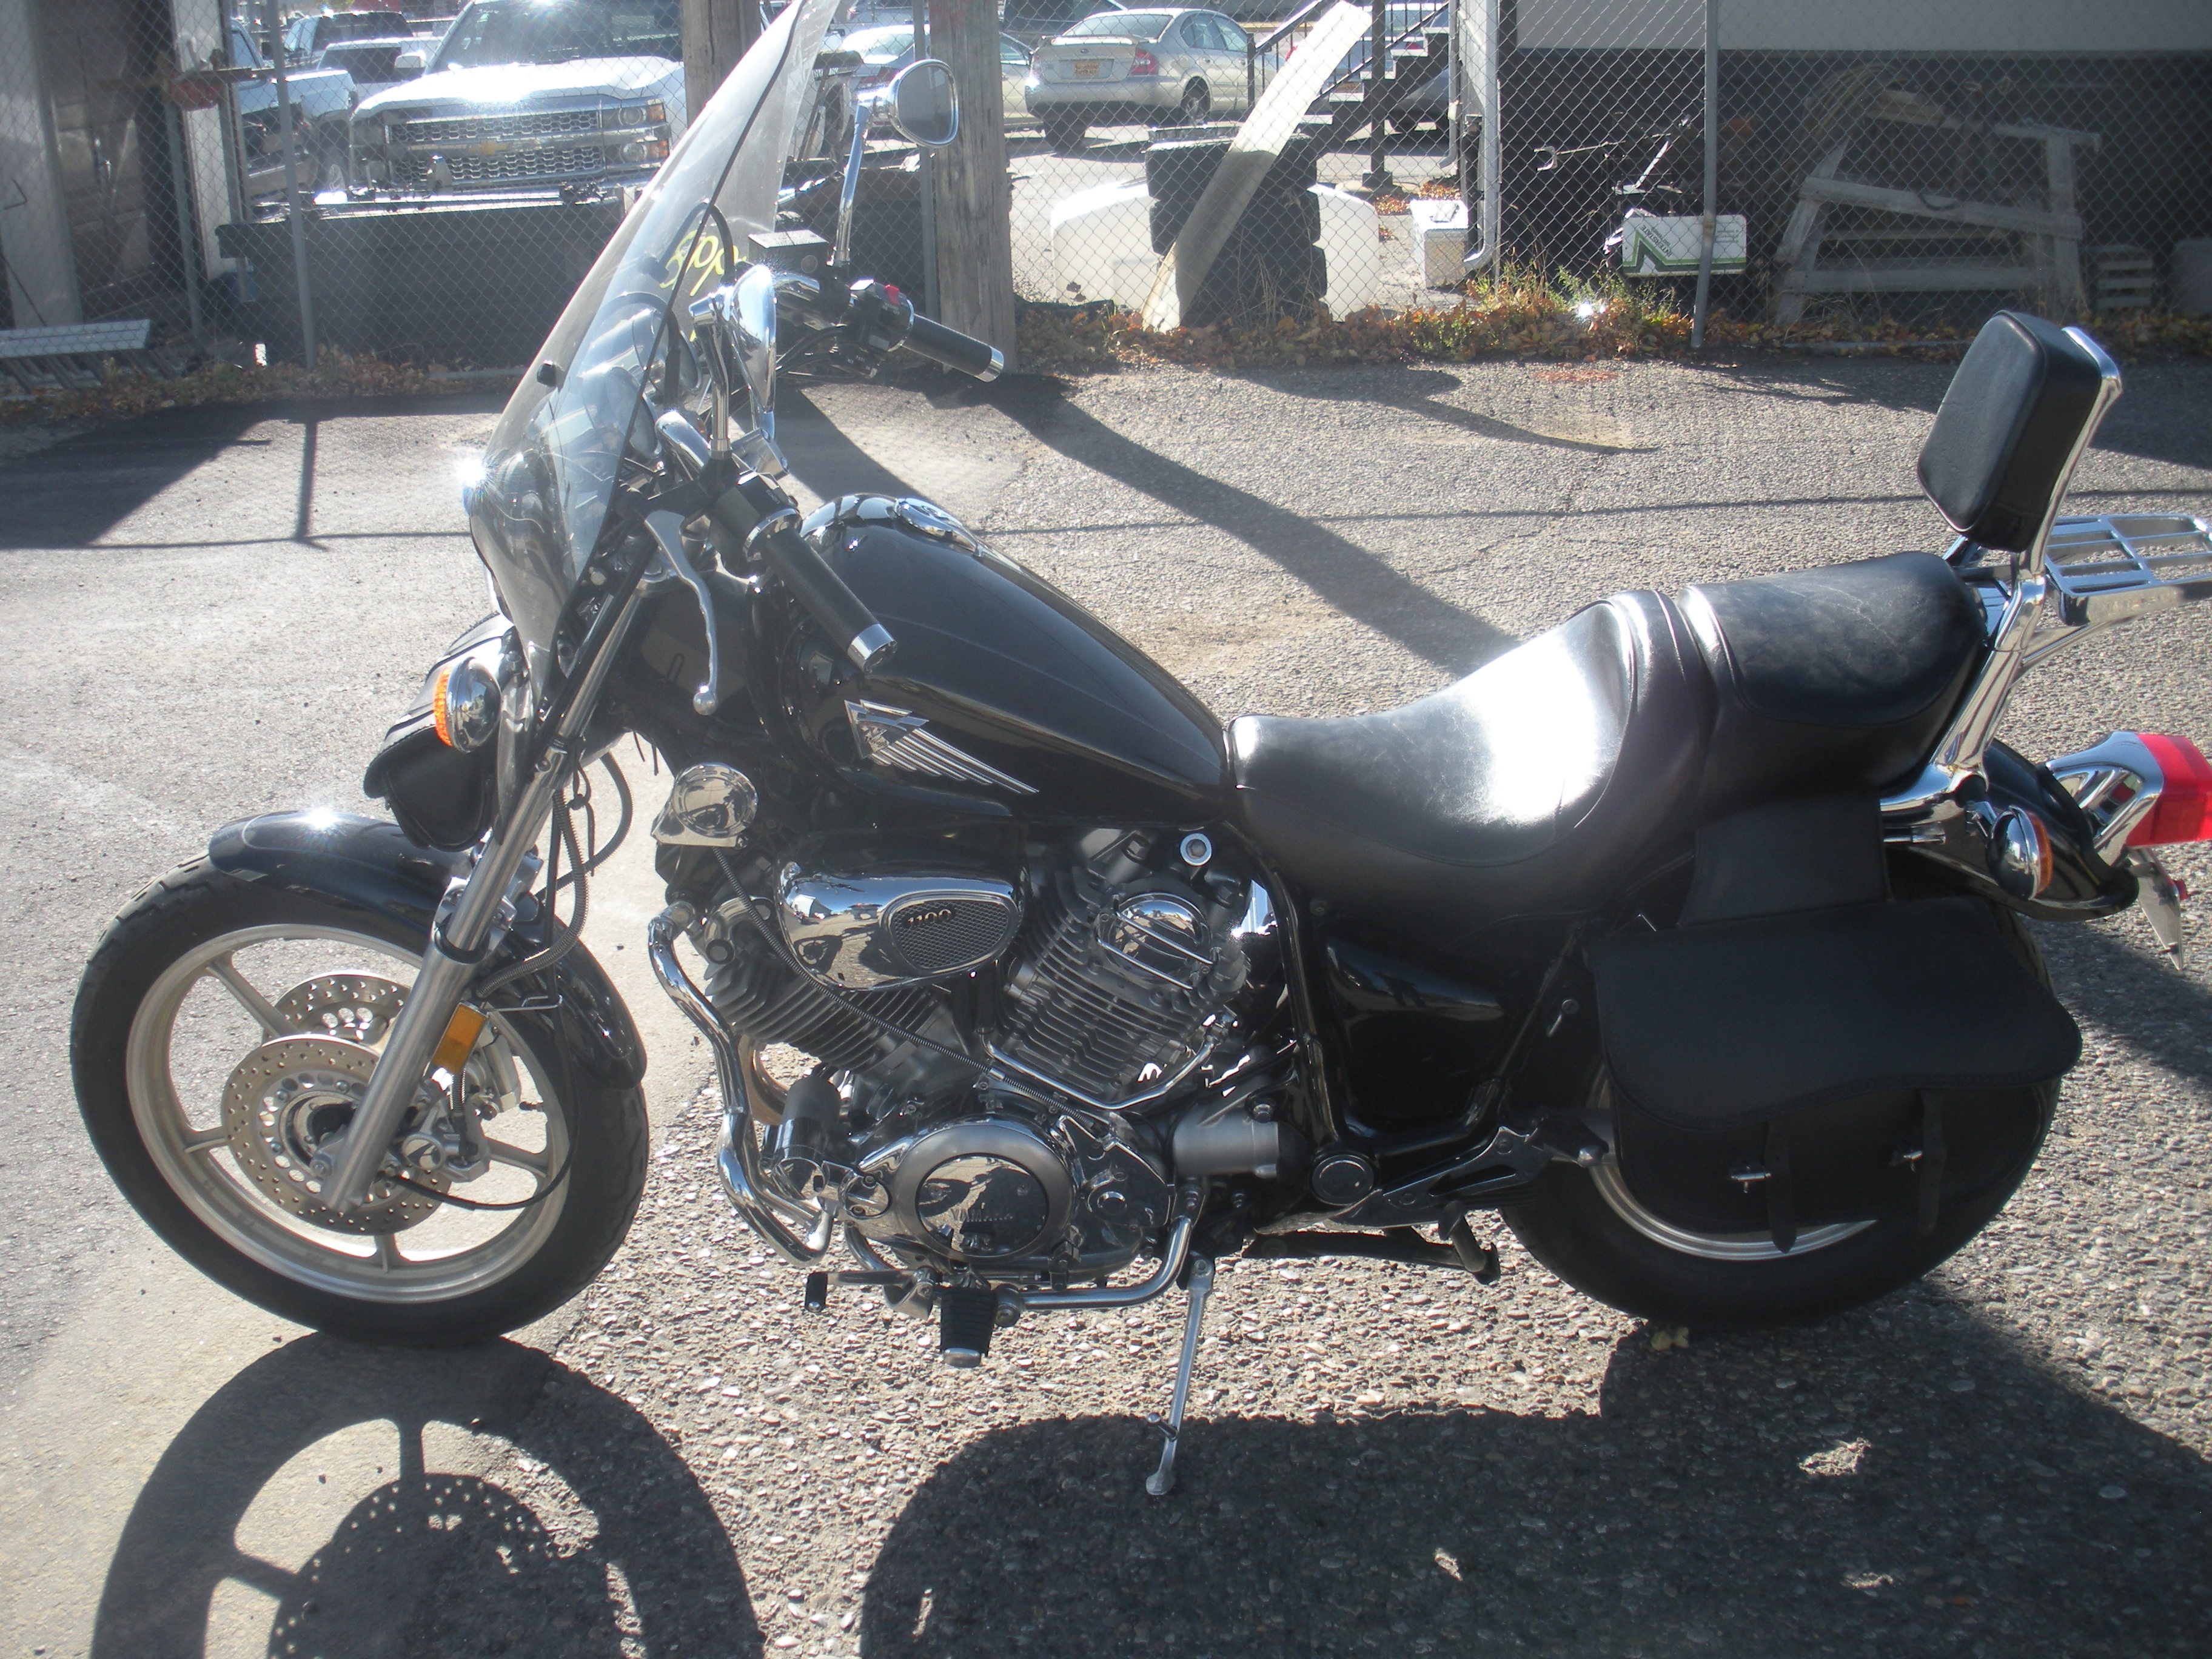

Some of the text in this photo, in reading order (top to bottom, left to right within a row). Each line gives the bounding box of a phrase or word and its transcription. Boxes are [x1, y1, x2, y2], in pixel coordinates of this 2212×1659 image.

[1640, 225, 1673, 257] INTERSTATE
[907, 909, 952, 927] 1100
[950, 1205, 1013, 1222] YAM
